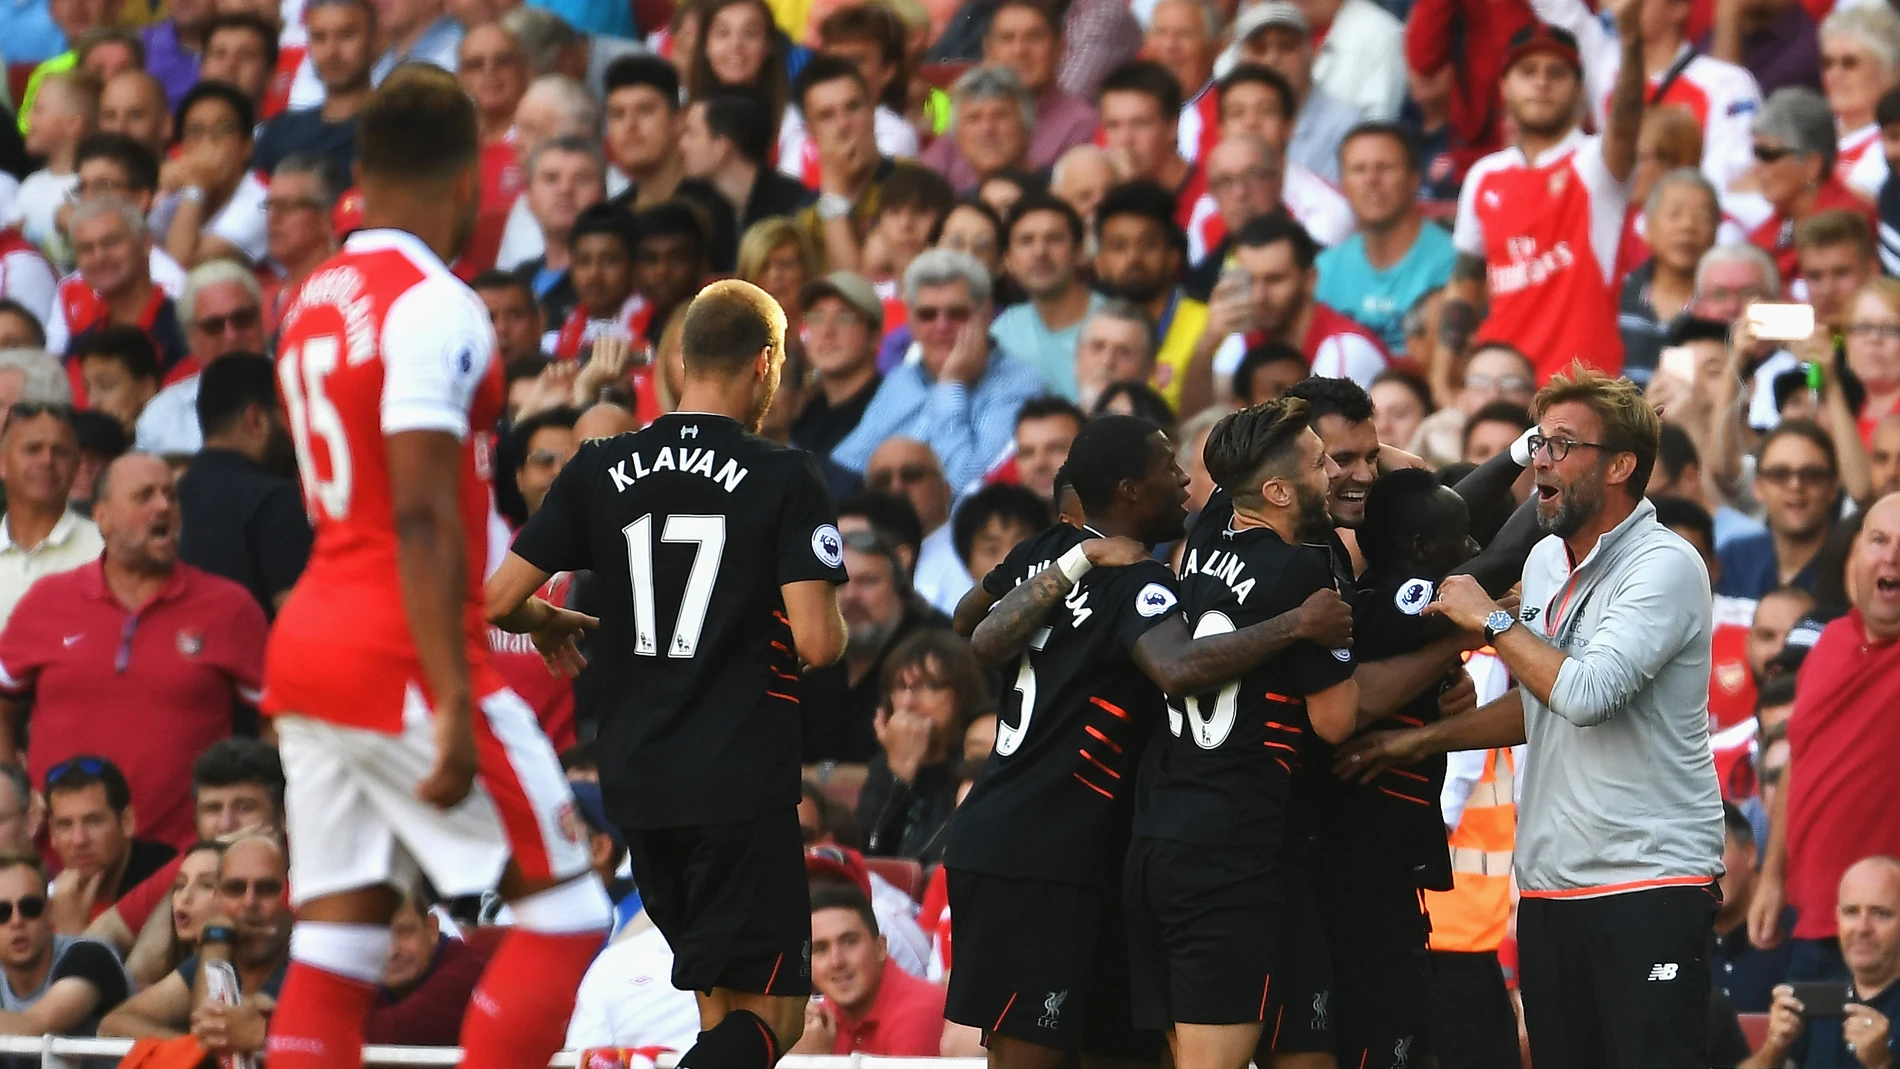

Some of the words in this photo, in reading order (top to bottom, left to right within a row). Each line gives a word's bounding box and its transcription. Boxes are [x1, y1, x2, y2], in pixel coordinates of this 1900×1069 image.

[277, 334, 353, 525] 15
[608, 446, 749, 493] KLAVAN
[621, 512, 727, 659] 17
[1037, 1017, 1058, 1030] LFC
